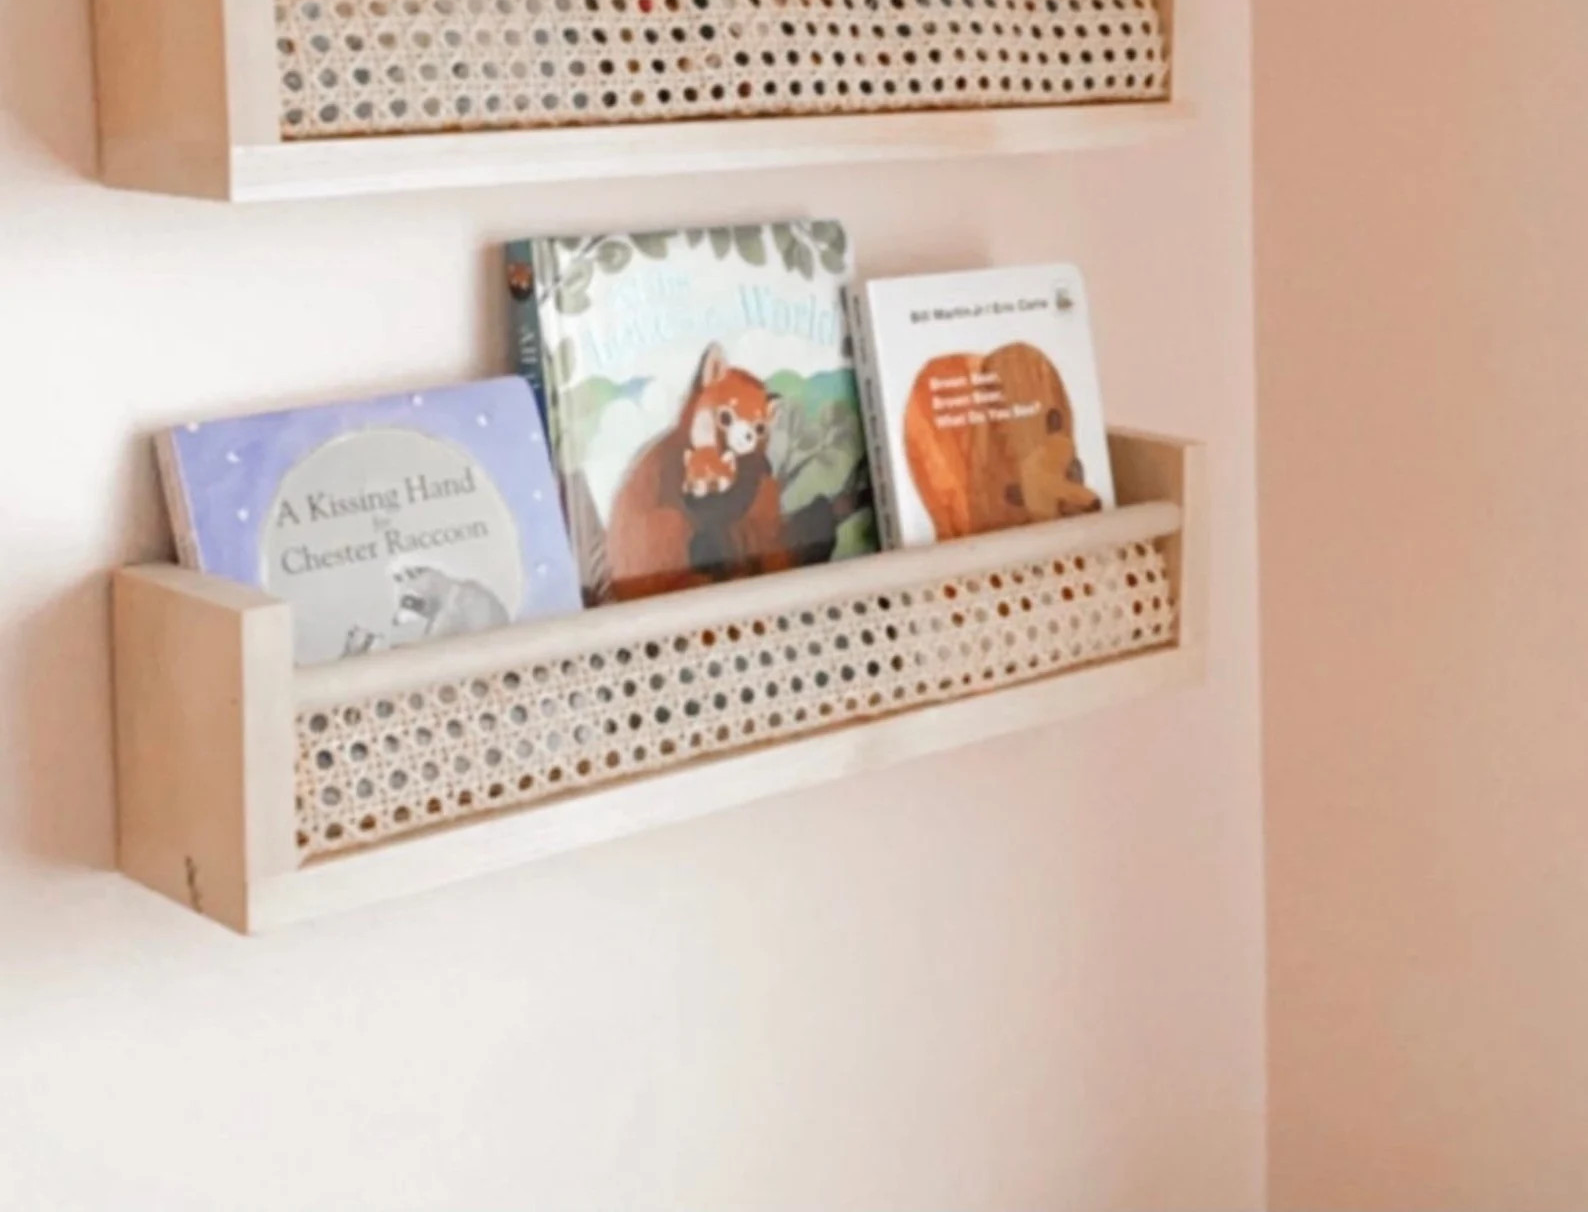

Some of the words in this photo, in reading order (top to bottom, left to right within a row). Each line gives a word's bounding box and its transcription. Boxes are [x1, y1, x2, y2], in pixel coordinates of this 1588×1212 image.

[276, 499, 300, 528] A
[307, 487, 401, 523] Kissing
[404, 466, 477, 504] Hand
[280, 540, 378, 575] Chester
[383, 520, 489, 555] Raccoon
